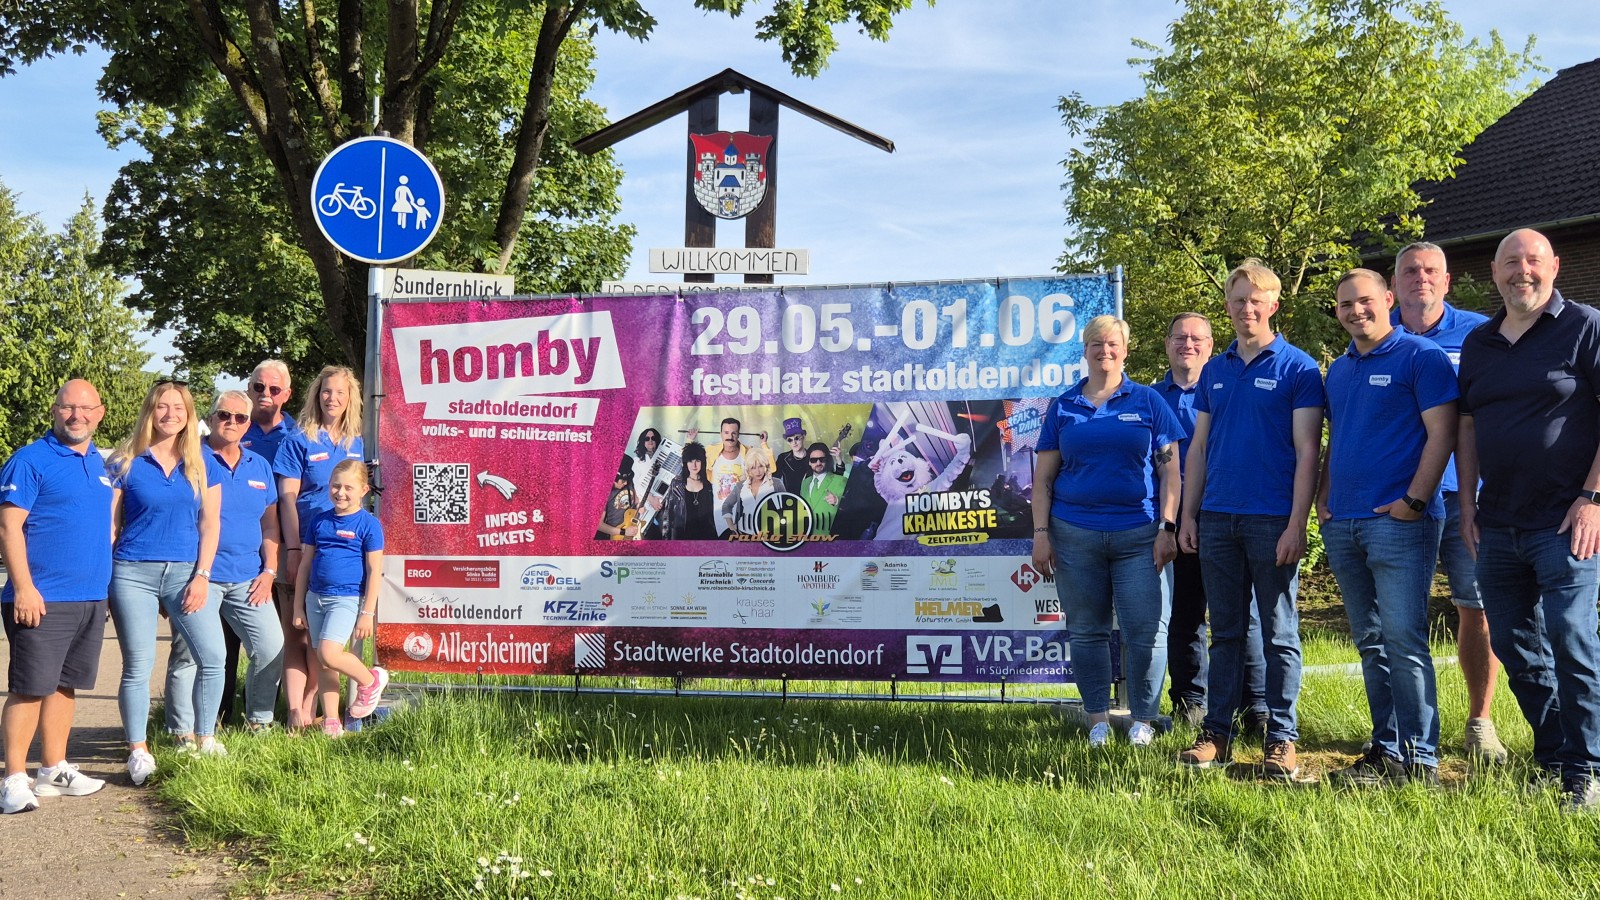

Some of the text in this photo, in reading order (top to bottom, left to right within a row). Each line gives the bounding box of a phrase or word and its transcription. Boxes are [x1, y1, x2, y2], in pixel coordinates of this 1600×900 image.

[662, 251, 798, 271] WILLKOMMEN
[394, 275, 502, 296] Sundernblick
[419, 329, 601, 385] homby
[691, 366, 831, 401] festplatz
[448, 399, 578, 419] stadtoldendorf
[422, 424, 592, 443] volks- und schützenfest
[906, 490, 991, 513] HOMBY'S
[485, 509, 544, 528] INFOS &
[903, 509, 997, 533] KRANKESTE
[476, 529, 535, 547] TICKETS
[728, 531, 839, 542] radio show
[927, 534, 980, 545] ZELTPARTY
[407, 569, 432, 578] ERGO
[797, 574, 840, 583] HOMBURG
[801, 582, 836, 590] APOTHEKE
[405, 593, 460, 604] mein
[543, 600, 578, 613] KFZ
[736, 596, 775, 607] krauses
[418, 604, 522, 620] stadtoldendorf
[568, 610, 607, 621] Zinke
[751, 608, 775, 618] haar
[914, 601, 983, 616] HELMER
[437, 631, 551, 664] Allersheimer
[613, 640, 884, 665] Stadtwerke Stadtoldendorf
[970, 635, 1071, 662] VR-Ba
[976, 665, 1073, 675] in Südniedersachs
